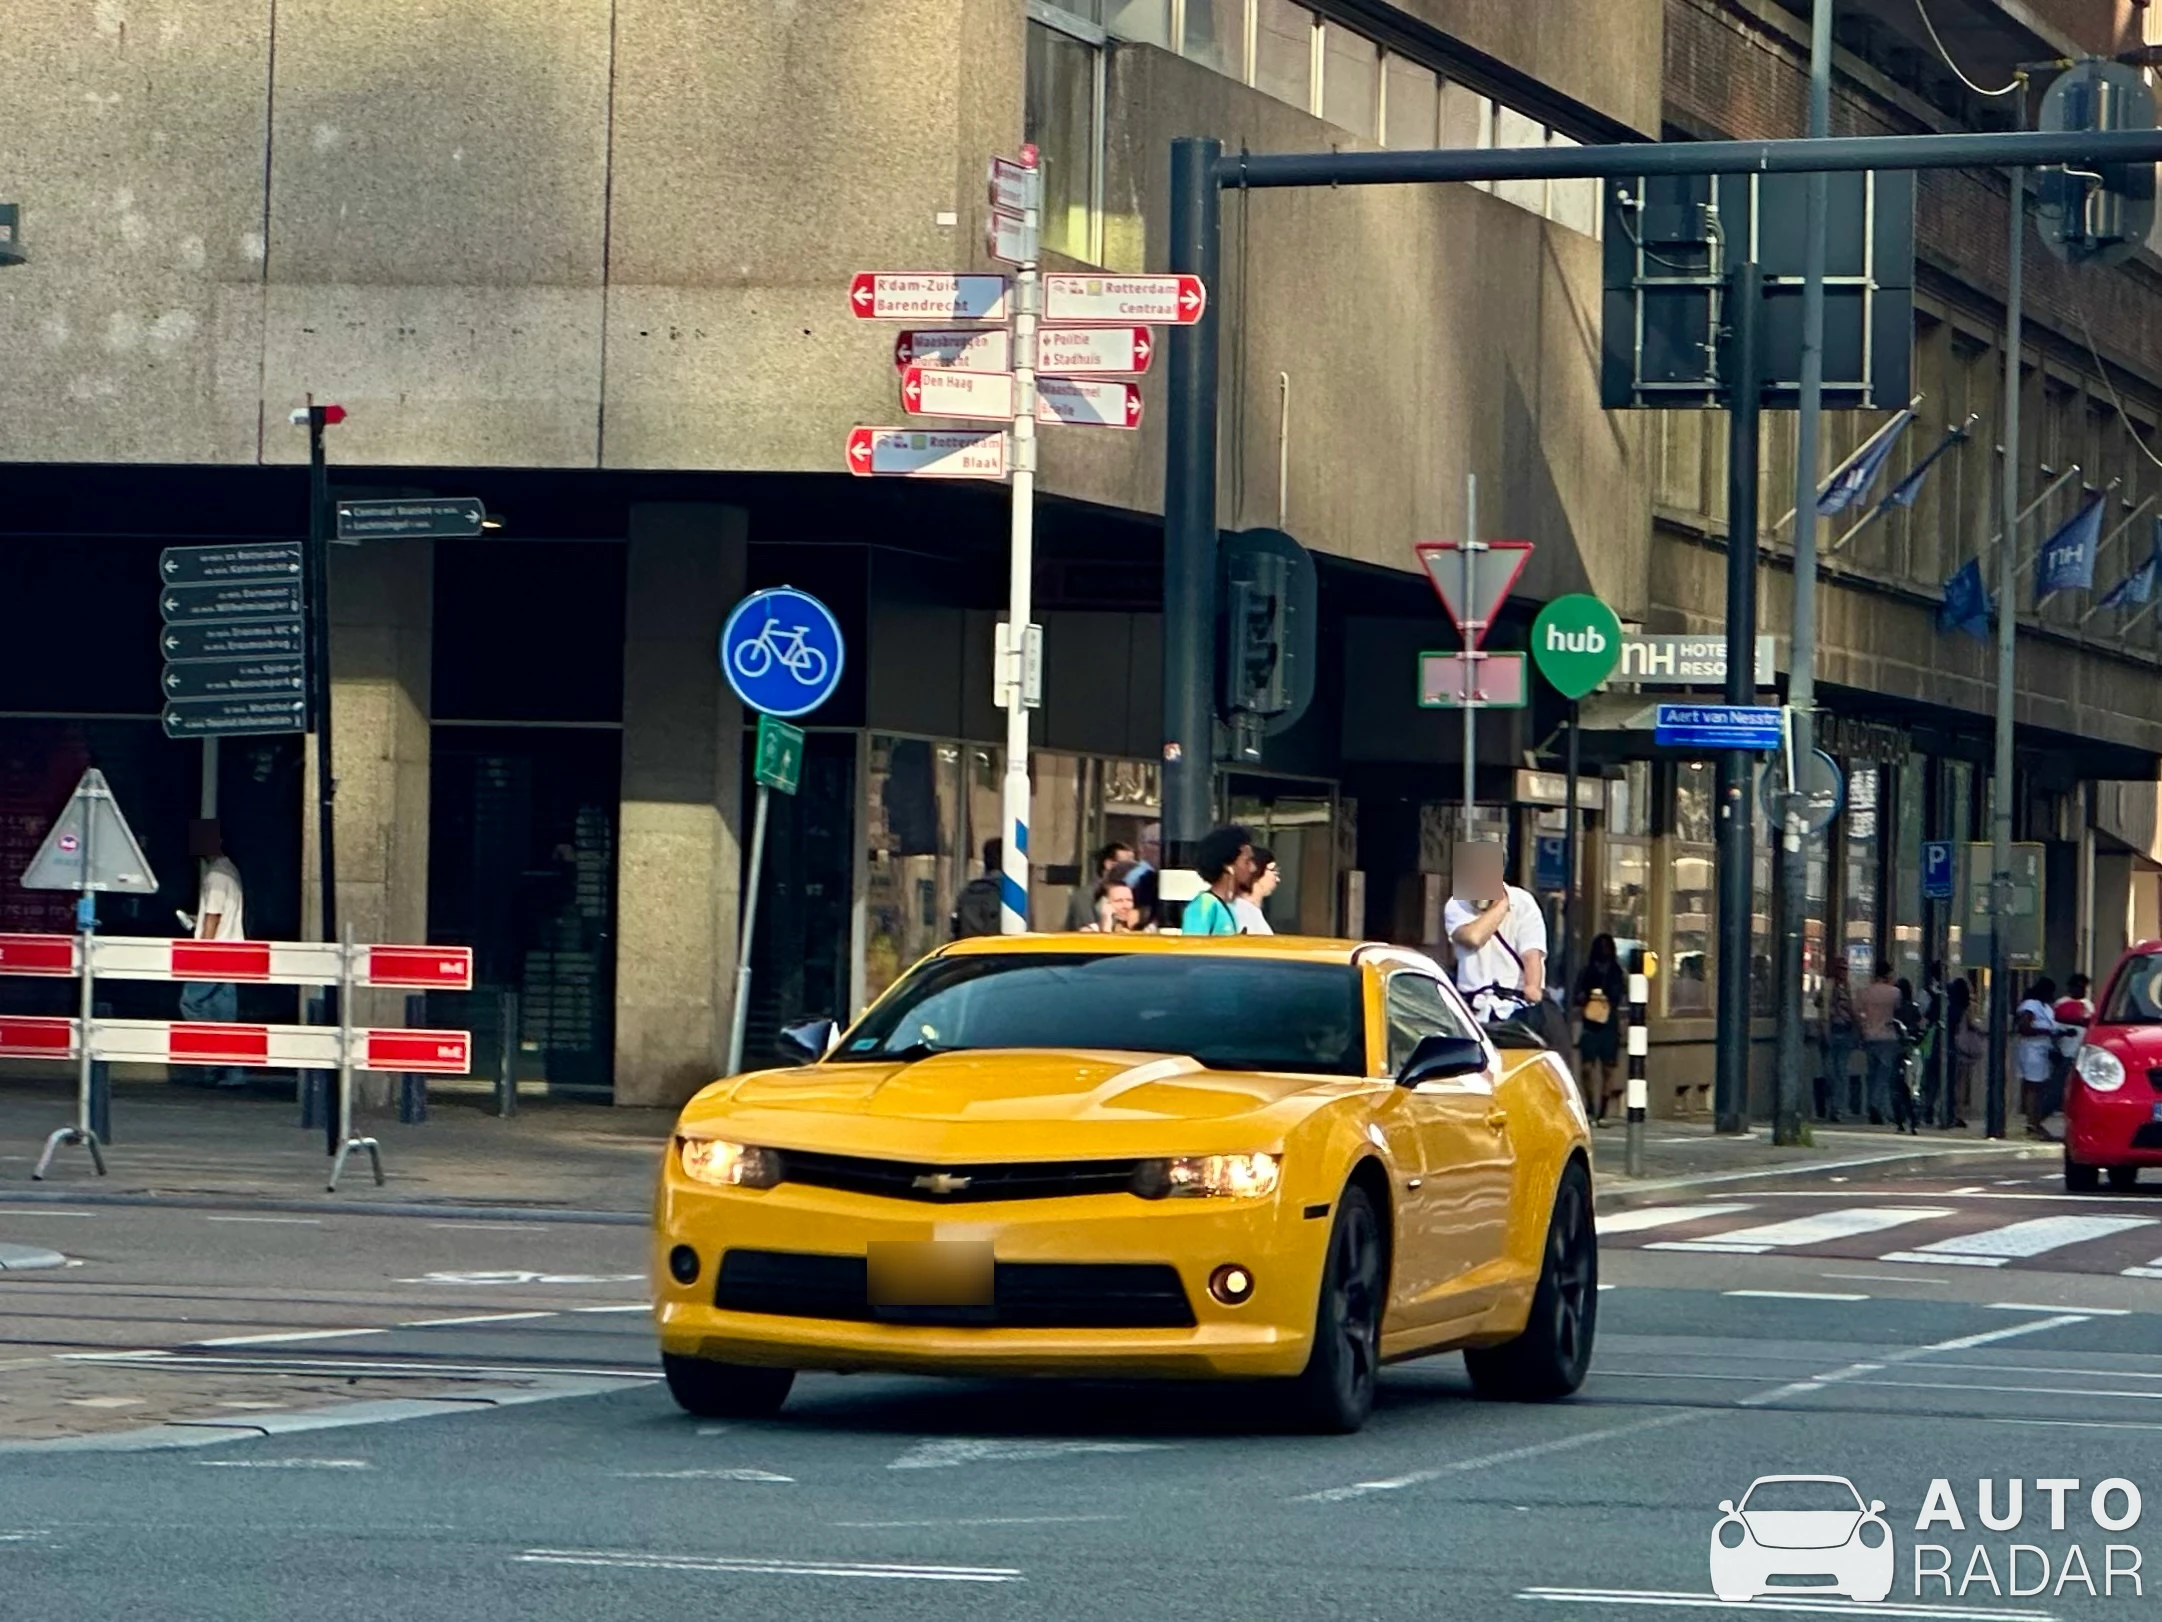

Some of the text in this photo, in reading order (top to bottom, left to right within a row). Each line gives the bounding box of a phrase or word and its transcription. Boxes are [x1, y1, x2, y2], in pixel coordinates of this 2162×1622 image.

[1105, 282, 1176, 295] Rotterdam
[877, 299, 969, 312] Barendrecht
[1119, 302, 1176, 315] Centraal
[1053, 353, 1101, 366] Stadhuis
[923, 374, 973, 392] Den Haag
[929, 435, 1001, 449] Rotterdam
[962, 456, 998, 469] Blaak
[1546, 623, 1607, 654] hub
[1666, 709, 1700, 723] Aert
[1702, 711, 1729, 724] van
[1928, 845, 1947, 874] P
